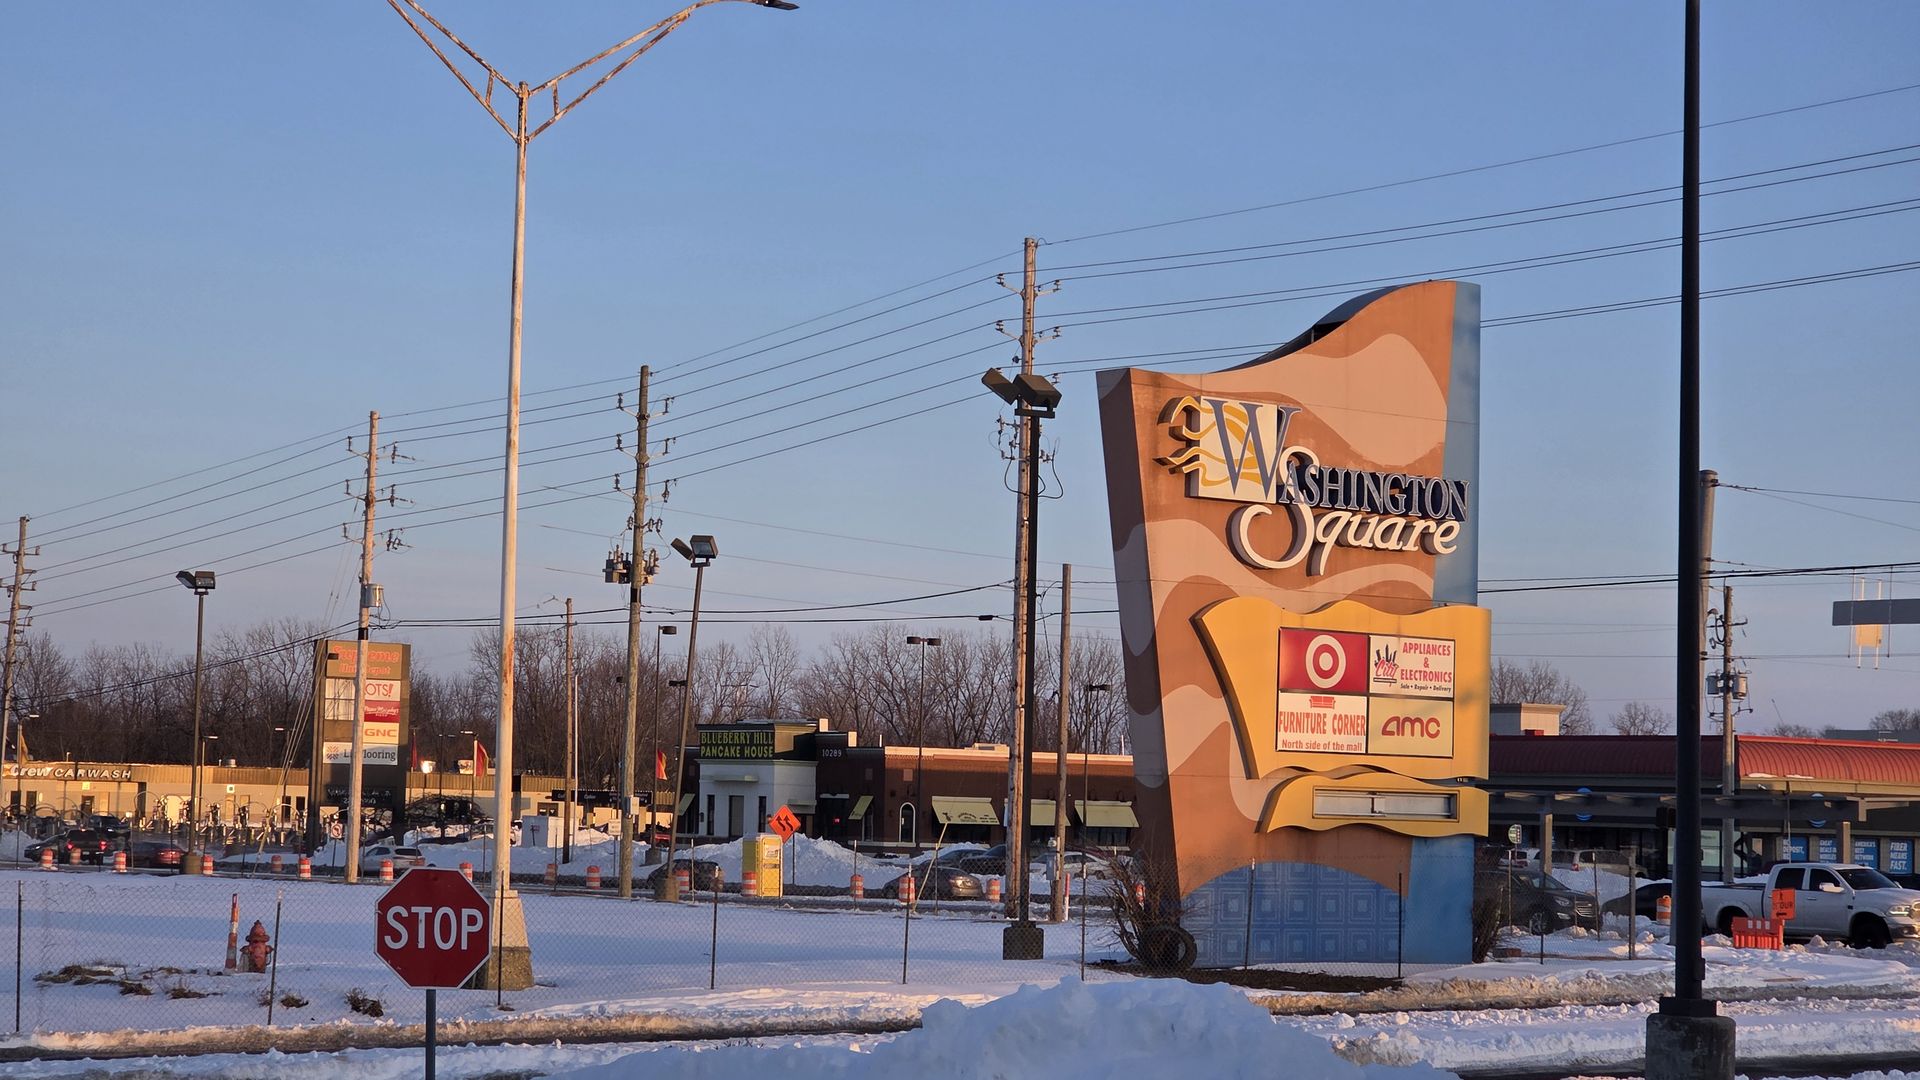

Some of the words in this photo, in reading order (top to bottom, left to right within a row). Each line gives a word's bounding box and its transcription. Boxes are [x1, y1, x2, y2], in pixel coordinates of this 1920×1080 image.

[1202, 398, 1470, 522] WASHINGTON
[1239, 445, 1461, 576] Square
[1402, 642, 1451, 656] APPLIANCES
[1423, 657, 1430, 668] &
[1400, 669, 1452, 683] ELECTRONICS
[366, 683, 394, 698] OTS!
[1433, 685, 1452, 693] Delivery
[1278, 711, 1327, 735] FURNITURE
[1332, 713, 1366, 737] CORNER
[365, 728, 397, 737] GNC
[701, 731, 751, 744] BLUEBERRY
[753, 731, 774, 744] HILL
[700, 746, 741, 757] PANCAKE
[744, 746, 774, 757] HOUSE
[1282, 739, 1303, 749] North
[1306, 741, 1321, 750] side
[1323, 741, 1331, 750] of
[1332, 742, 1345, 751] the
[1346, 742, 1362, 752] mall
[363, 749, 396, 762] looring
[822, 749, 842, 757] 10289
[384, 905, 484, 951] STOP
